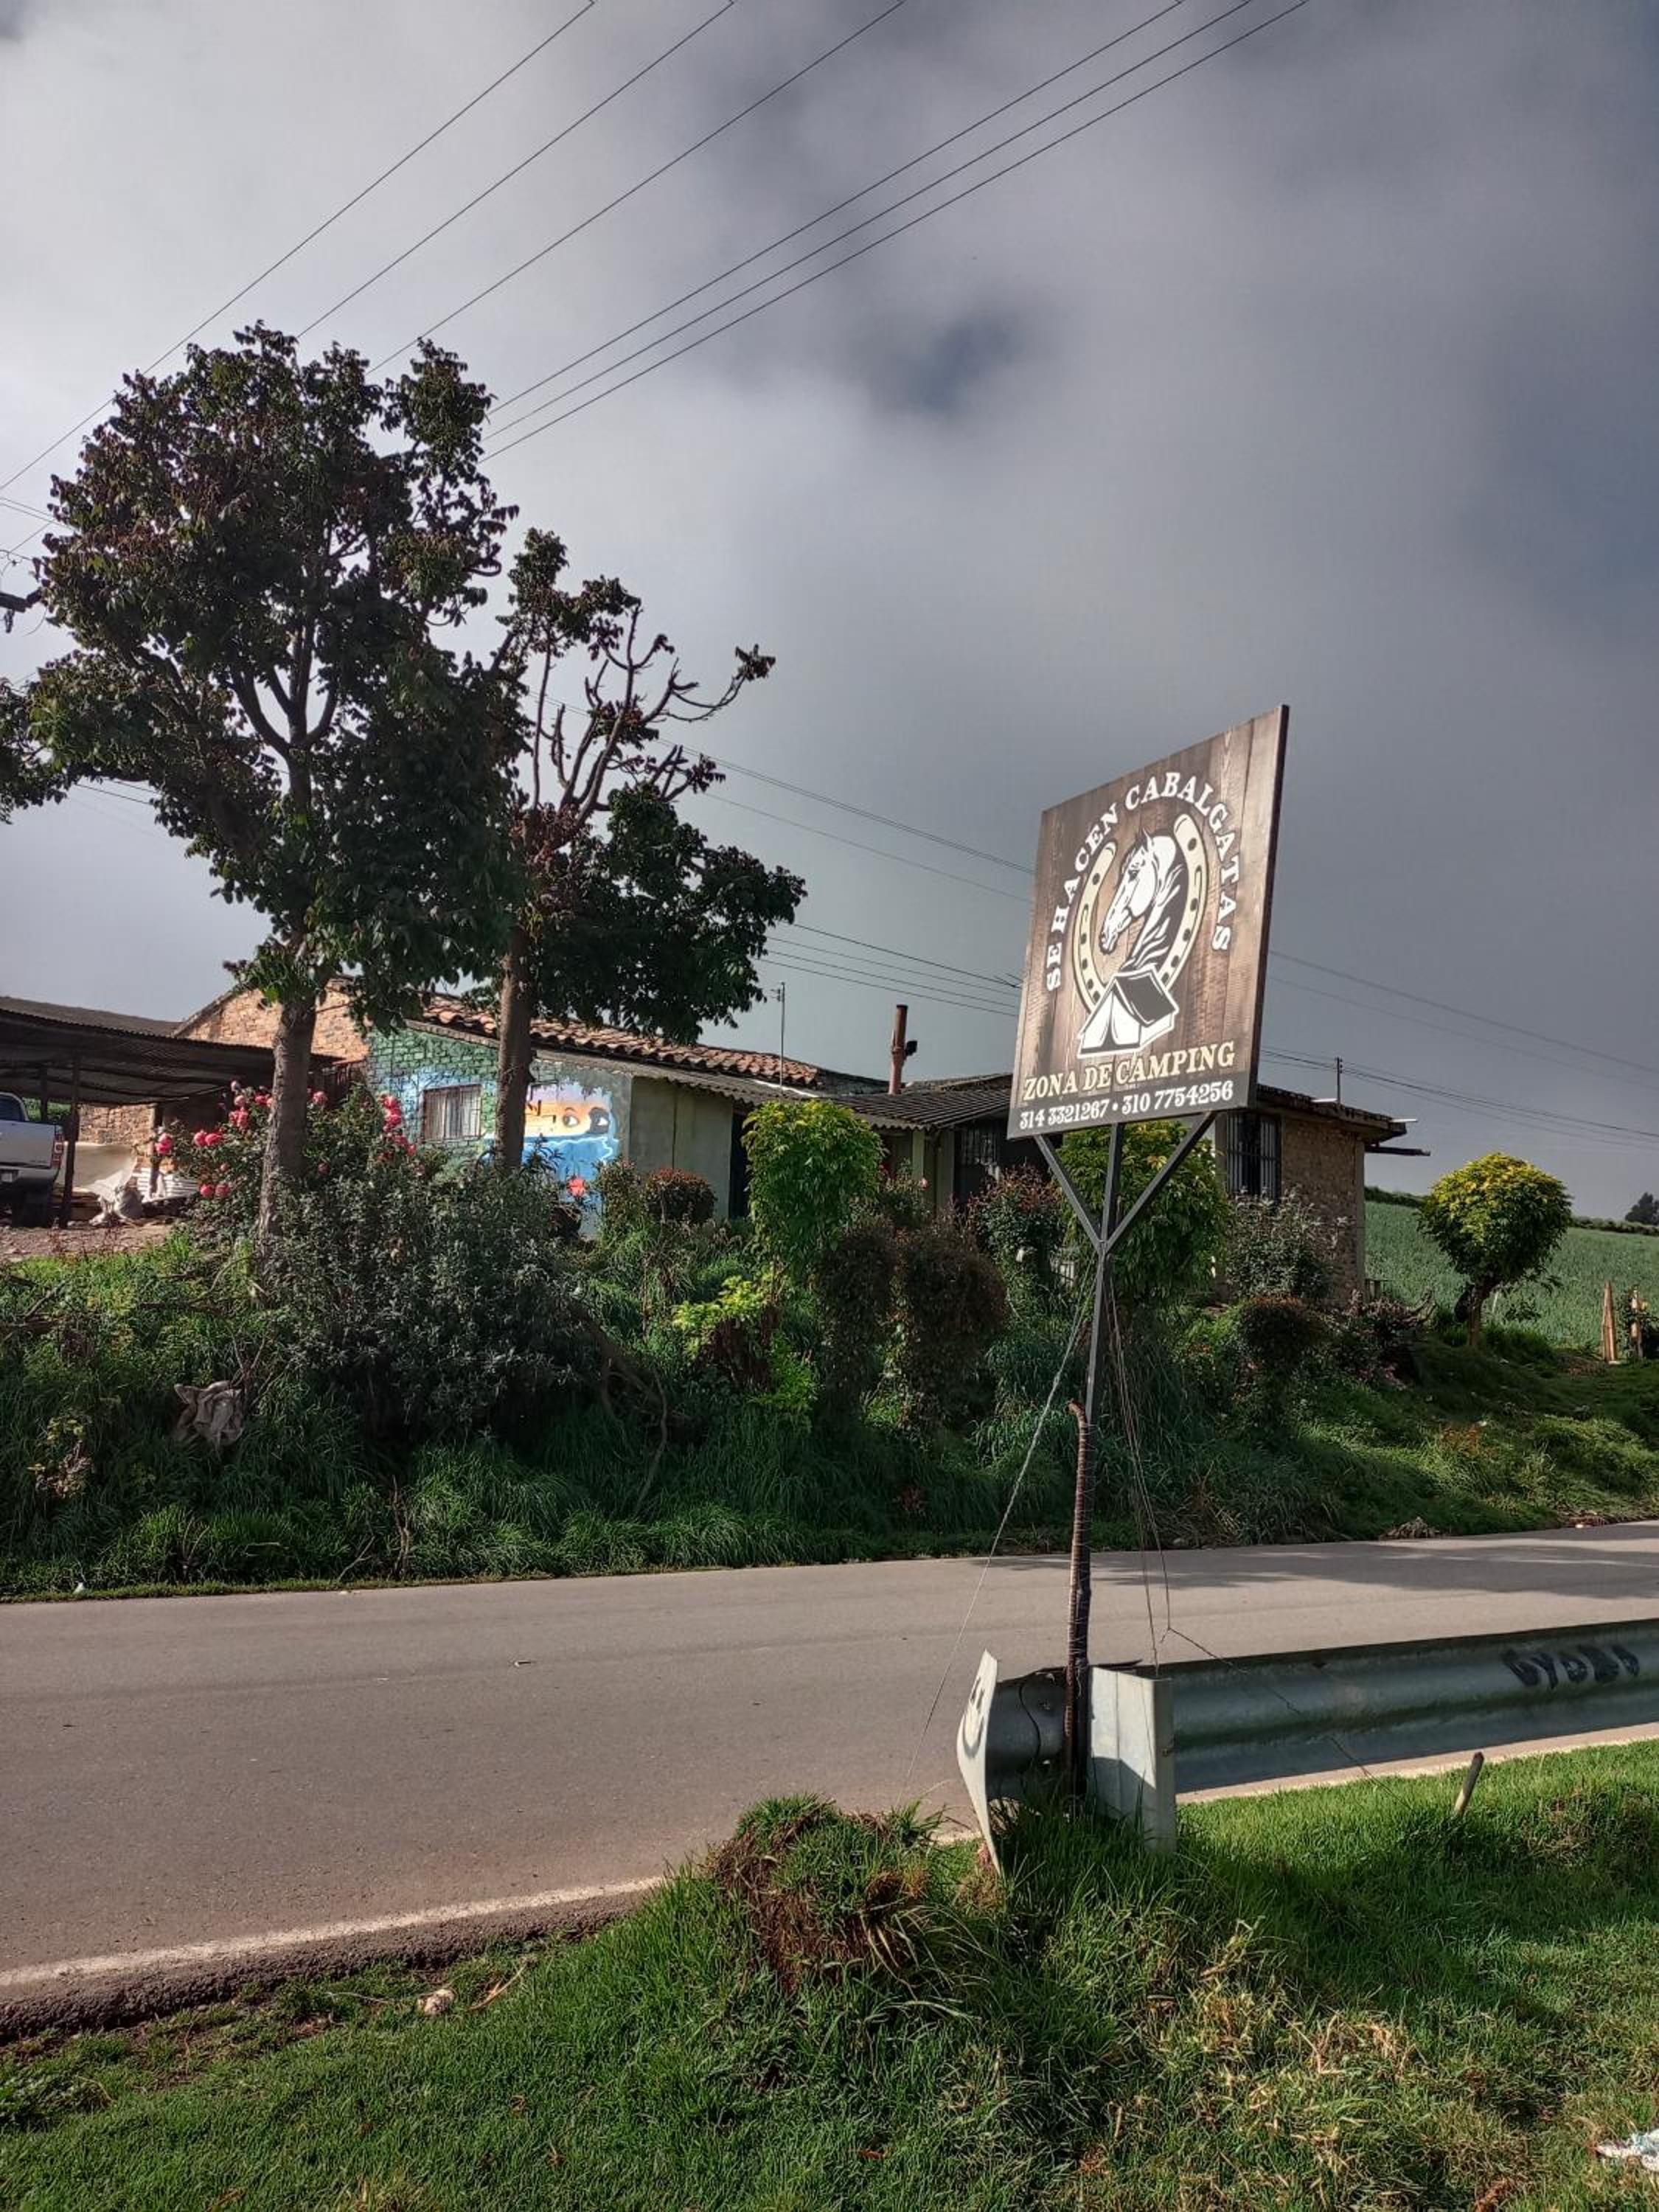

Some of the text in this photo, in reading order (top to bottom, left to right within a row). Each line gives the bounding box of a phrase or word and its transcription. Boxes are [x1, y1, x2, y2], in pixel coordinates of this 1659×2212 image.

[1046, 771, 1240, 992] SE HACEN CABALGATAS
[1023, 1040, 1236, 1101] ZONA DE CAMPING
[1019, 1108, 1046, 1130] 314
[1121, 1093, 1151, 1116] 310
[1153, 1079, 1234, 1110] 7754256
